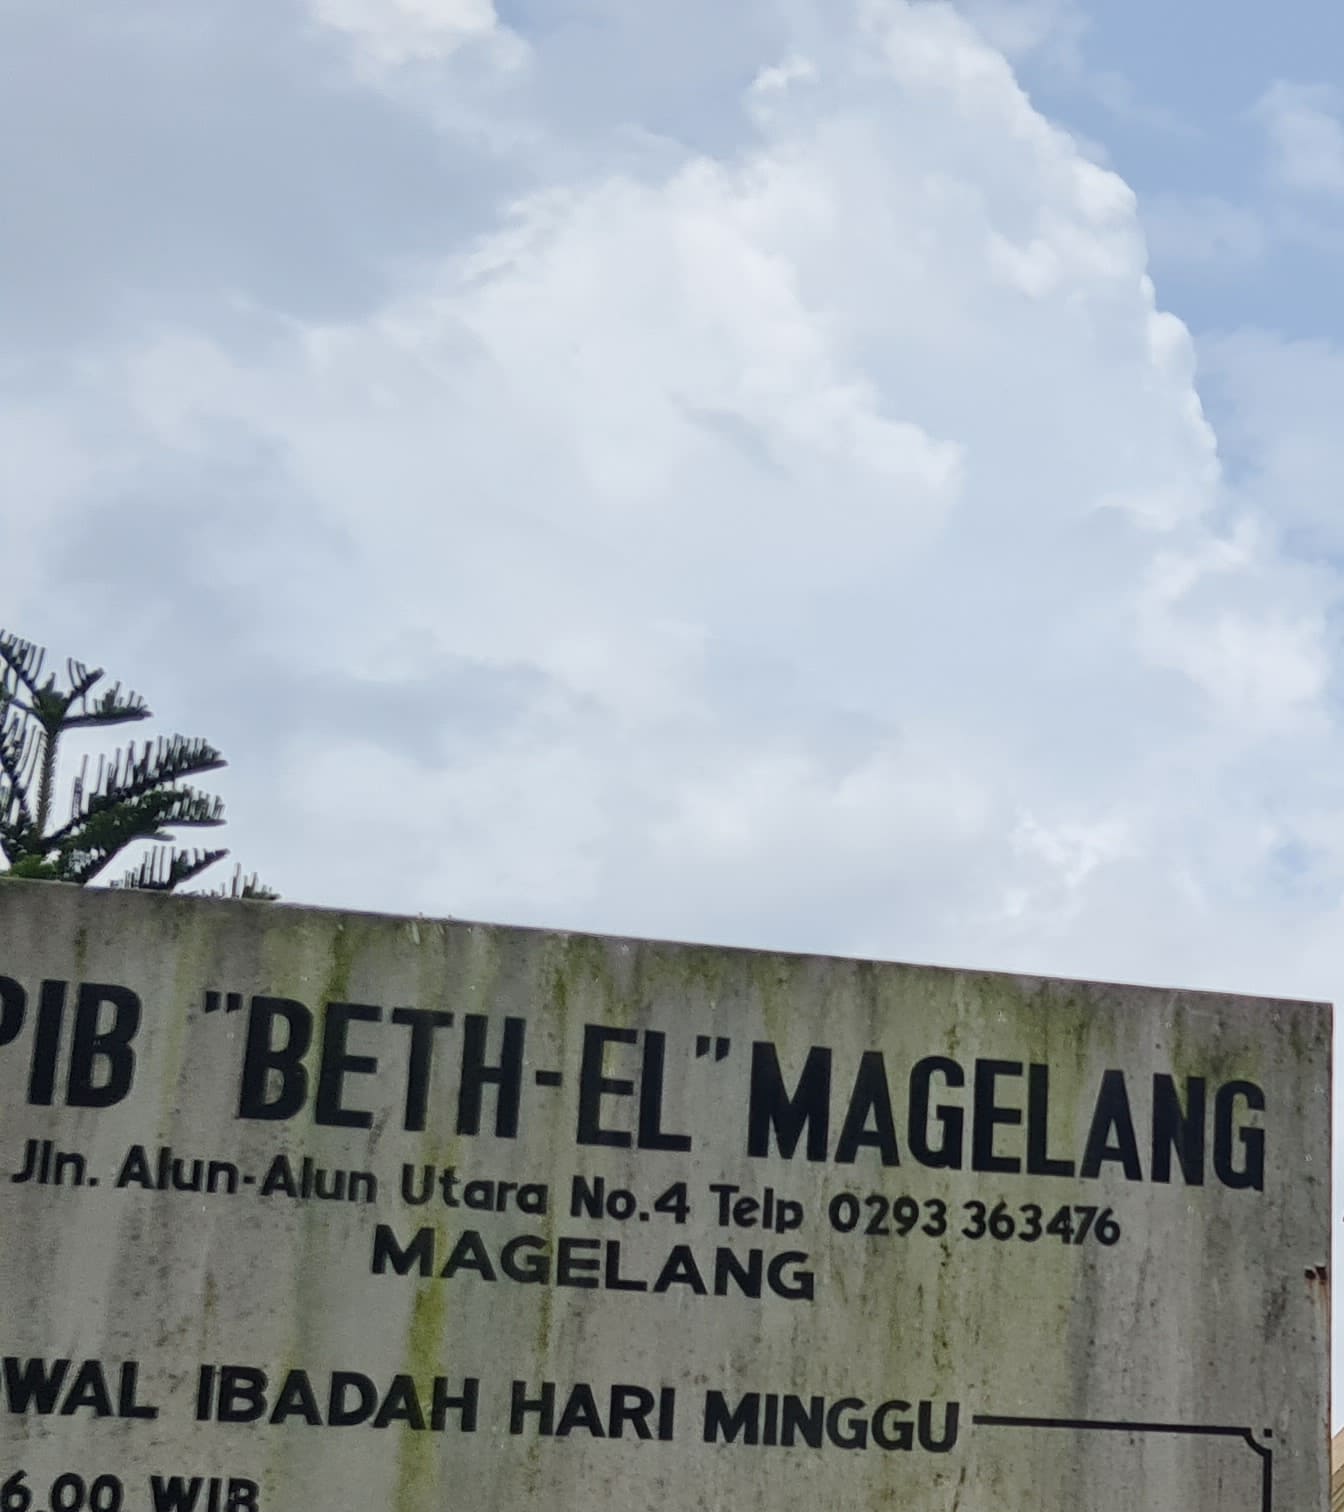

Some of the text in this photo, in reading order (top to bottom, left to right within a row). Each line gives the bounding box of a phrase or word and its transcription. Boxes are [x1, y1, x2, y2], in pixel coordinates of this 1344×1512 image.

[746, 1041, 1266, 1193] MAGELANG
[11, 1138, 1121, 1247] Jln. Alun-Alun Utara No.4 Telp 0293 363476
[371, 1221, 815, 1302] MAGELANG
[2, 1356, 960, 1453] WAL IBADAH HARI MINGGU
